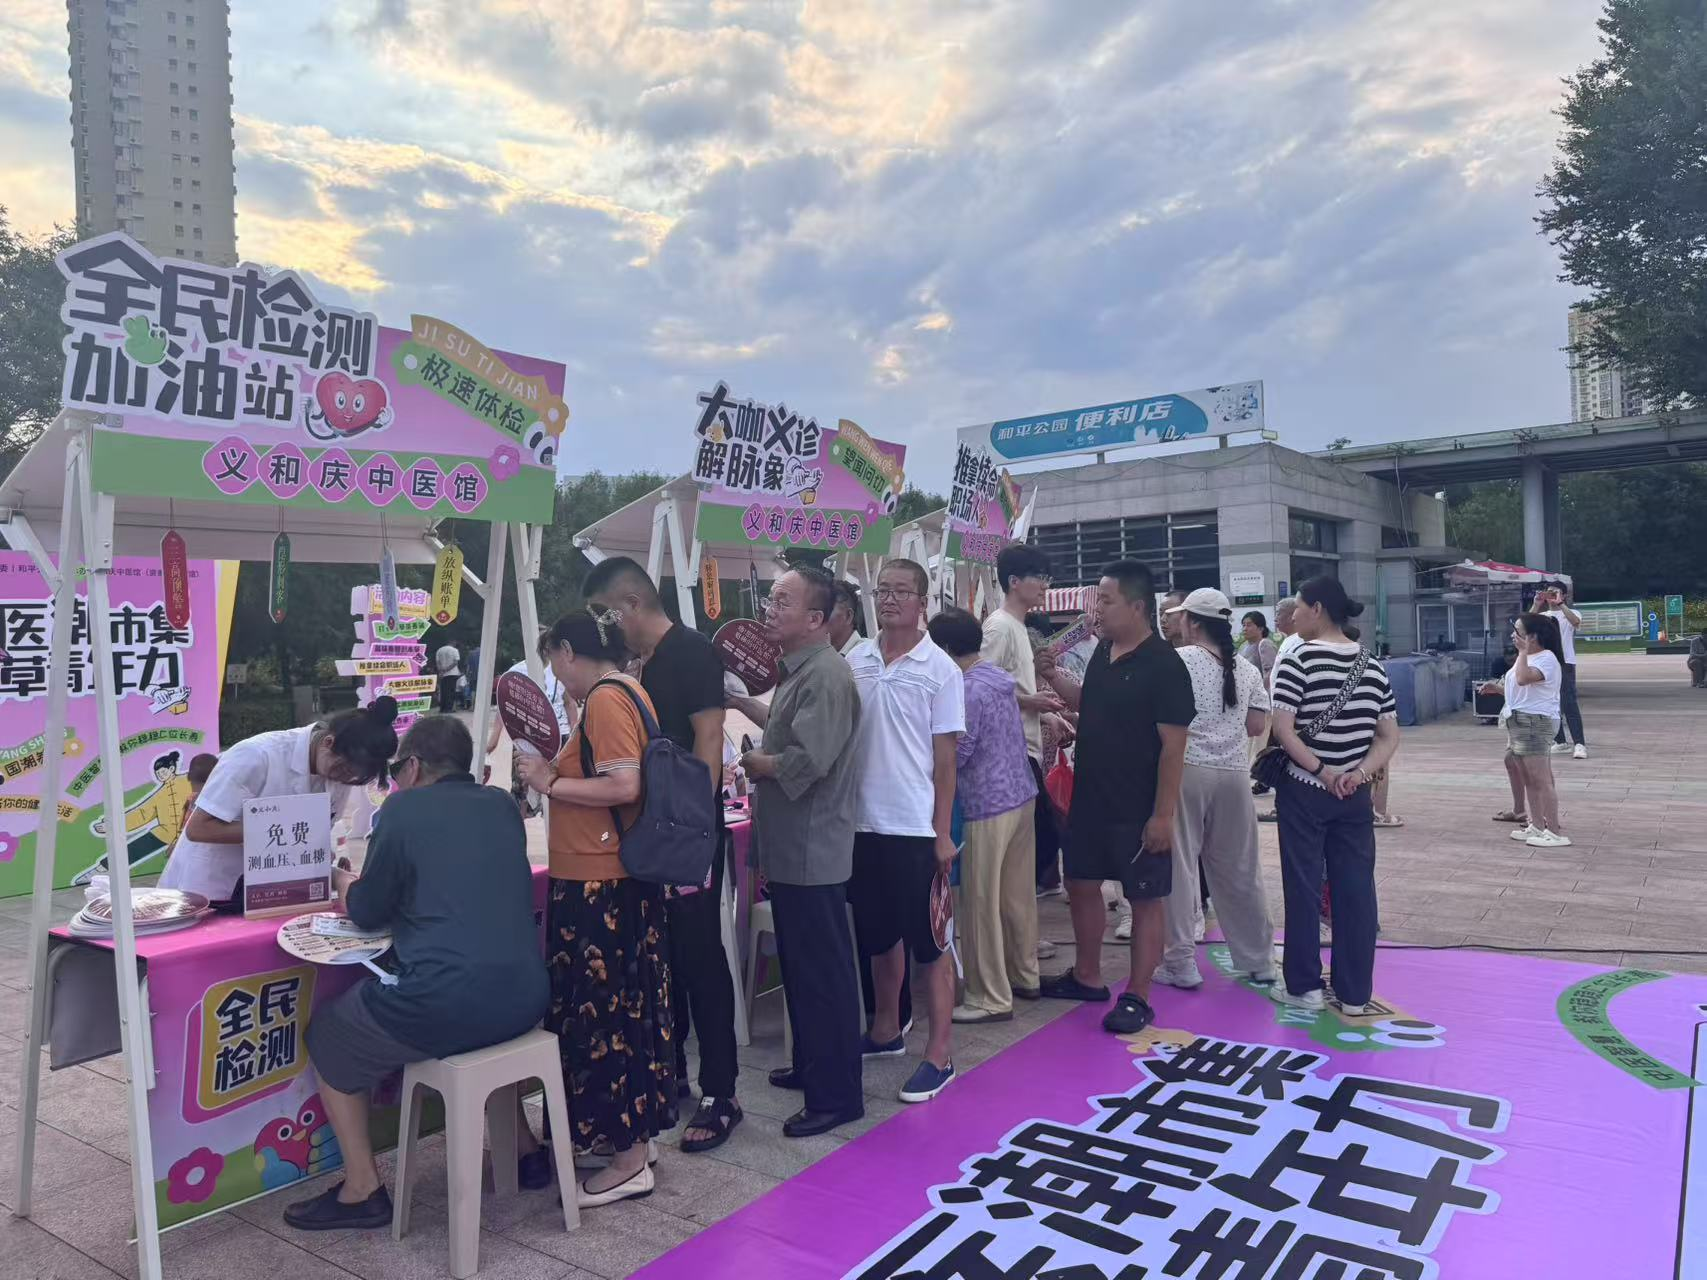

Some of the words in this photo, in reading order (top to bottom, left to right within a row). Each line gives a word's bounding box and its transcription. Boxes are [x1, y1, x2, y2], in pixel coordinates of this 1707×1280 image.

[64, 239, 372, 376] 全民检测
[69, 331, 298, 422] 加油站
[418, 323, 438, 343] JI
[446, 334, 471, 357] SU
[476, 352, 494, 374] TI
[496, 372, 538, 400] JIAN
[420, 352, 526, 435] 极速体检
[997, 418, 1069, 440] 和平公园
[1074, 400, 1173, 432] 便利店
[697, 384, 820, 458] 大咖义诊
[215, 448, 480, 503] 义和庆中医馆
[696, 438, 785, 491] 解脉象
[840, 446, 886, 493] 望闻问切
[746, 510, 859, 542] 义和庆中医馆
[374, 589, 427, 605] 活内容
[440, 556, 456, 608] 放纵账单
[248, 847, 326, 872] 测血压、血糖
[265, 820, 310, 848] 免费
[215, 976, 300, 1042] 全民
[213, 1021, 298, 1094] 检测
